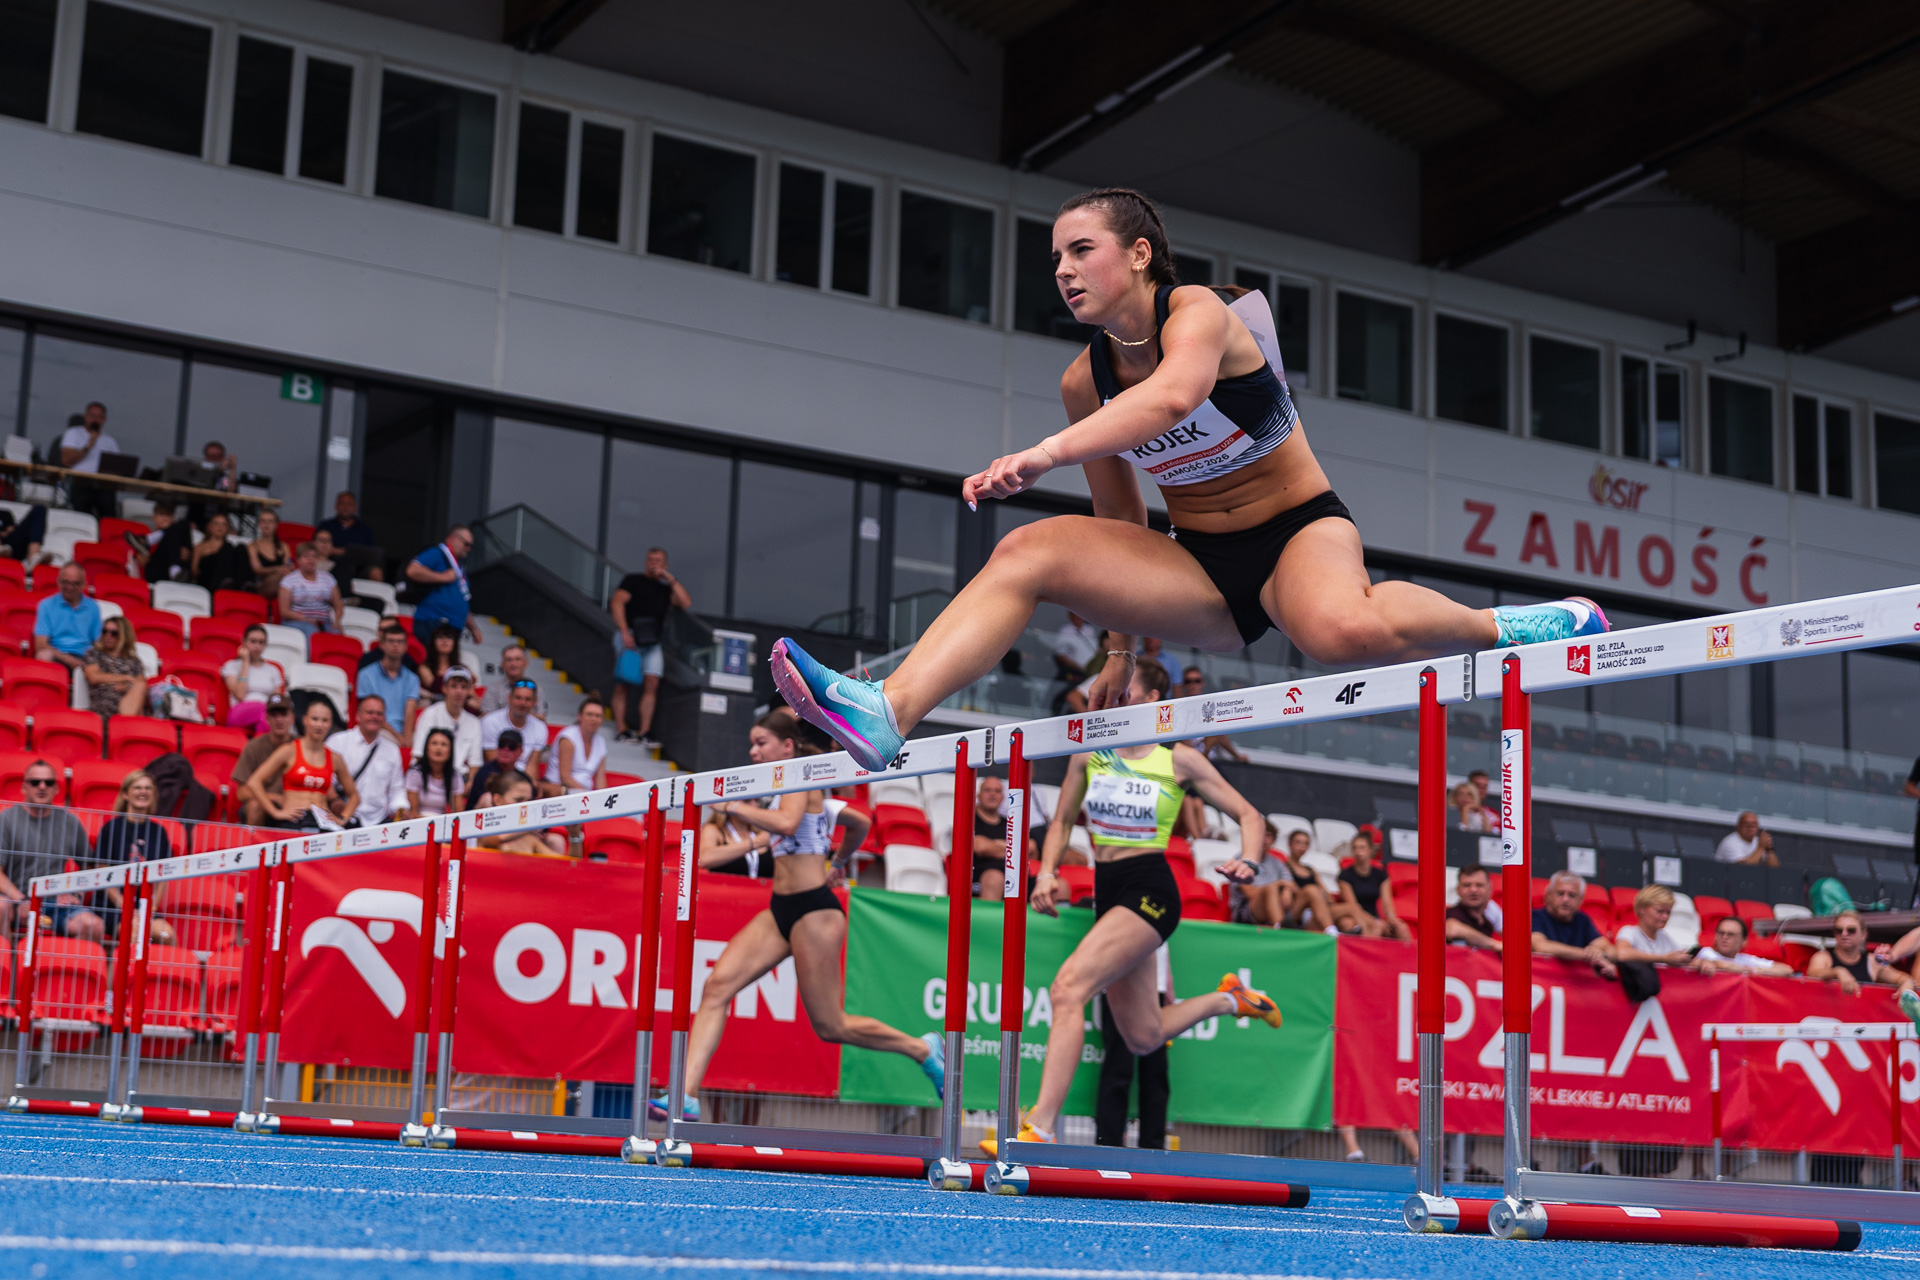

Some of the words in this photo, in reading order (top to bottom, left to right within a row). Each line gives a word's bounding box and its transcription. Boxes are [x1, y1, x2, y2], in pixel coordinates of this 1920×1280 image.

[291, 373, 313, 400] B
[1131, 421, 1210, 459] ROJEK
[1160, 461, 1205, 481] ZAMOŚĆ
[1203, 453, 1230, 467] 2026
[1462, 498, 1769, 605] ZAMOŚĆ
[1804, 614, 1849, 627] Ministerstwo
[1804, 627, 1827, 638] Sportu
[1833, 620, 1864, 633] Turystyki
[1597, 643, 1608, 653] 80.
[1609, 641, 1626, 651] PZLA
[1597, 648, 1633, 660] MISTRZOSTWA
[1634, 645, 1653, 655] POLSKI
[1653, 644, 1664, 652] U20
[1708, 648, 1733, 659] PZLA
[1597, 658, 1628, 670] ZAMOŚĆ
[1629, 656, 1647, 666] 2026
[1335, 681, 1367, 706] 4F
[1216, 698, 1245, 709] Ministerstwo
[1216, 707, 1231, 717] Sportu
[1234, 704, 1254, 714] Turystyki
[1282, 705, 1305, 716] ORLEN
[889, 751, 911, 770] 4F
[1124, 781, 1152, 795] 310
[1501, 761, 1517, 831] polanik
[1087, 801, 1154, 820] MARCZUK
[1006, 815, 1016, 870] polanik
[1397, 972, 1691, 1083] PZLA
[1396, 1077, 1464, 1099] POSKI
[1466, 1082, 1545, 1104] ZWIEK
[1547, 1088, 1616, 1108] LEKKIEJ
[1617, 1093, 1691, 1113] ATLETYKI
